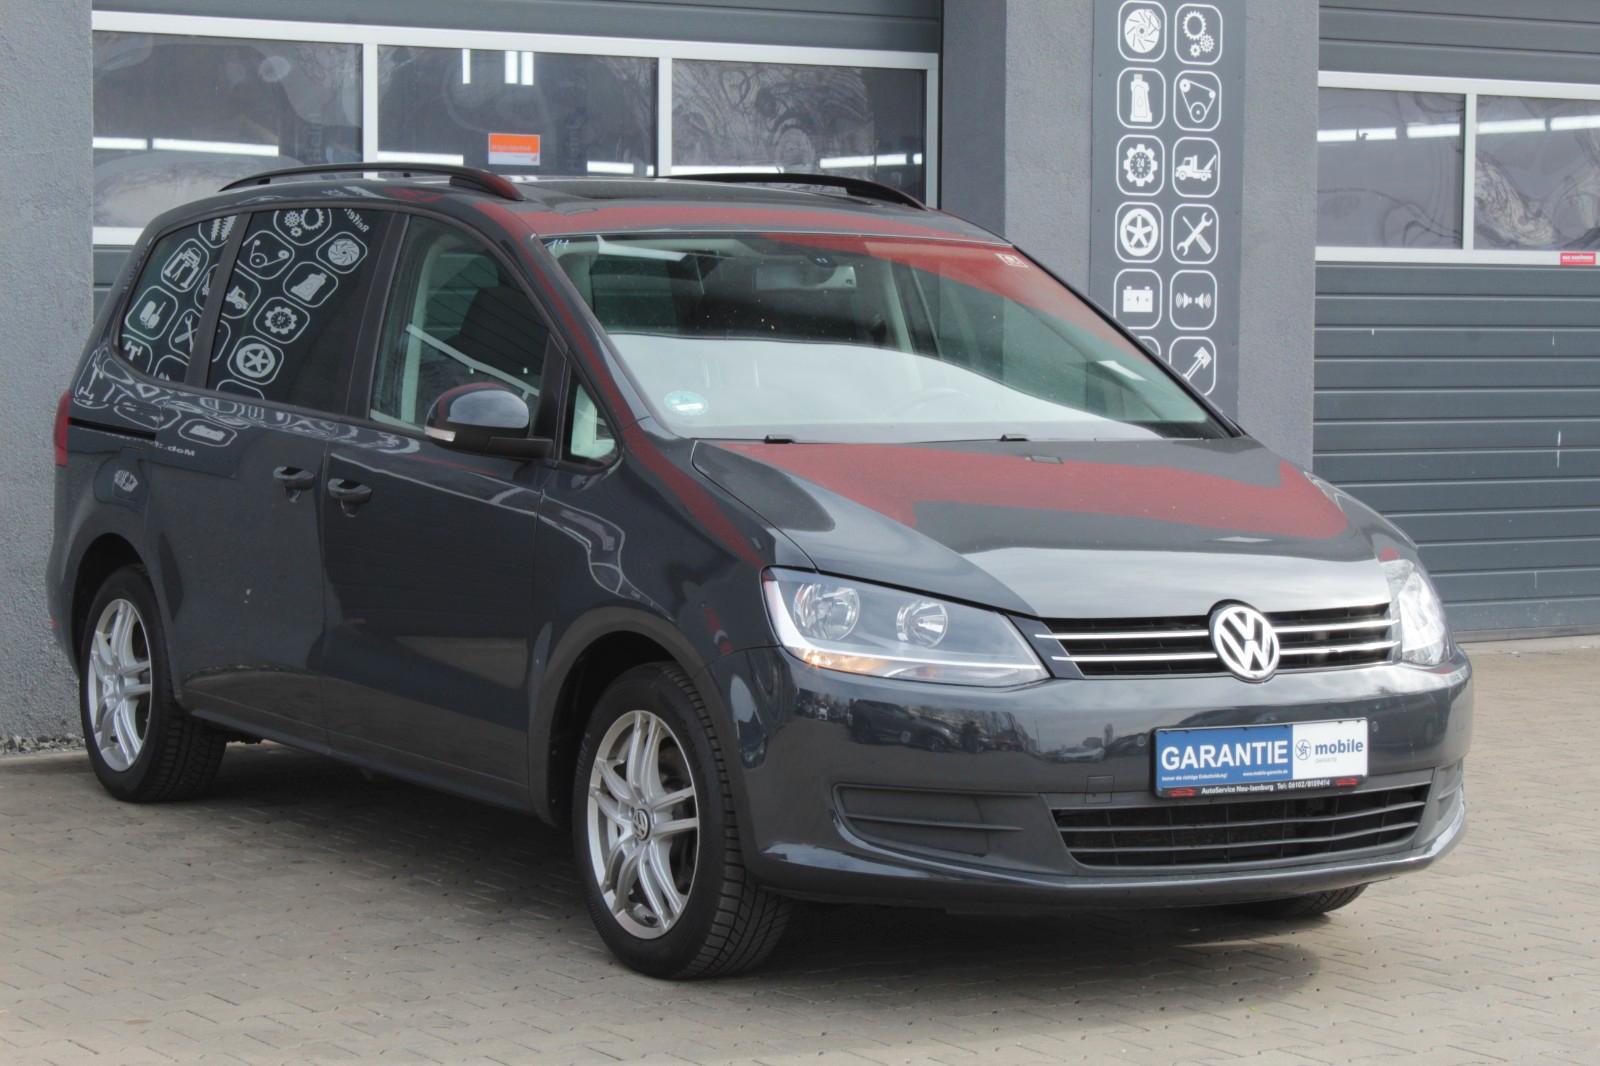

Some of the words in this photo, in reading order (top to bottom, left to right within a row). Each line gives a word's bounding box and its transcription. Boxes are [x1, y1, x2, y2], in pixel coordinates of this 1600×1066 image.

[1214, 605, 1280, 679] VW
[1161, 740, 1288, 770] GARANTIE
[1315, 739, 1363, 755] mobile
